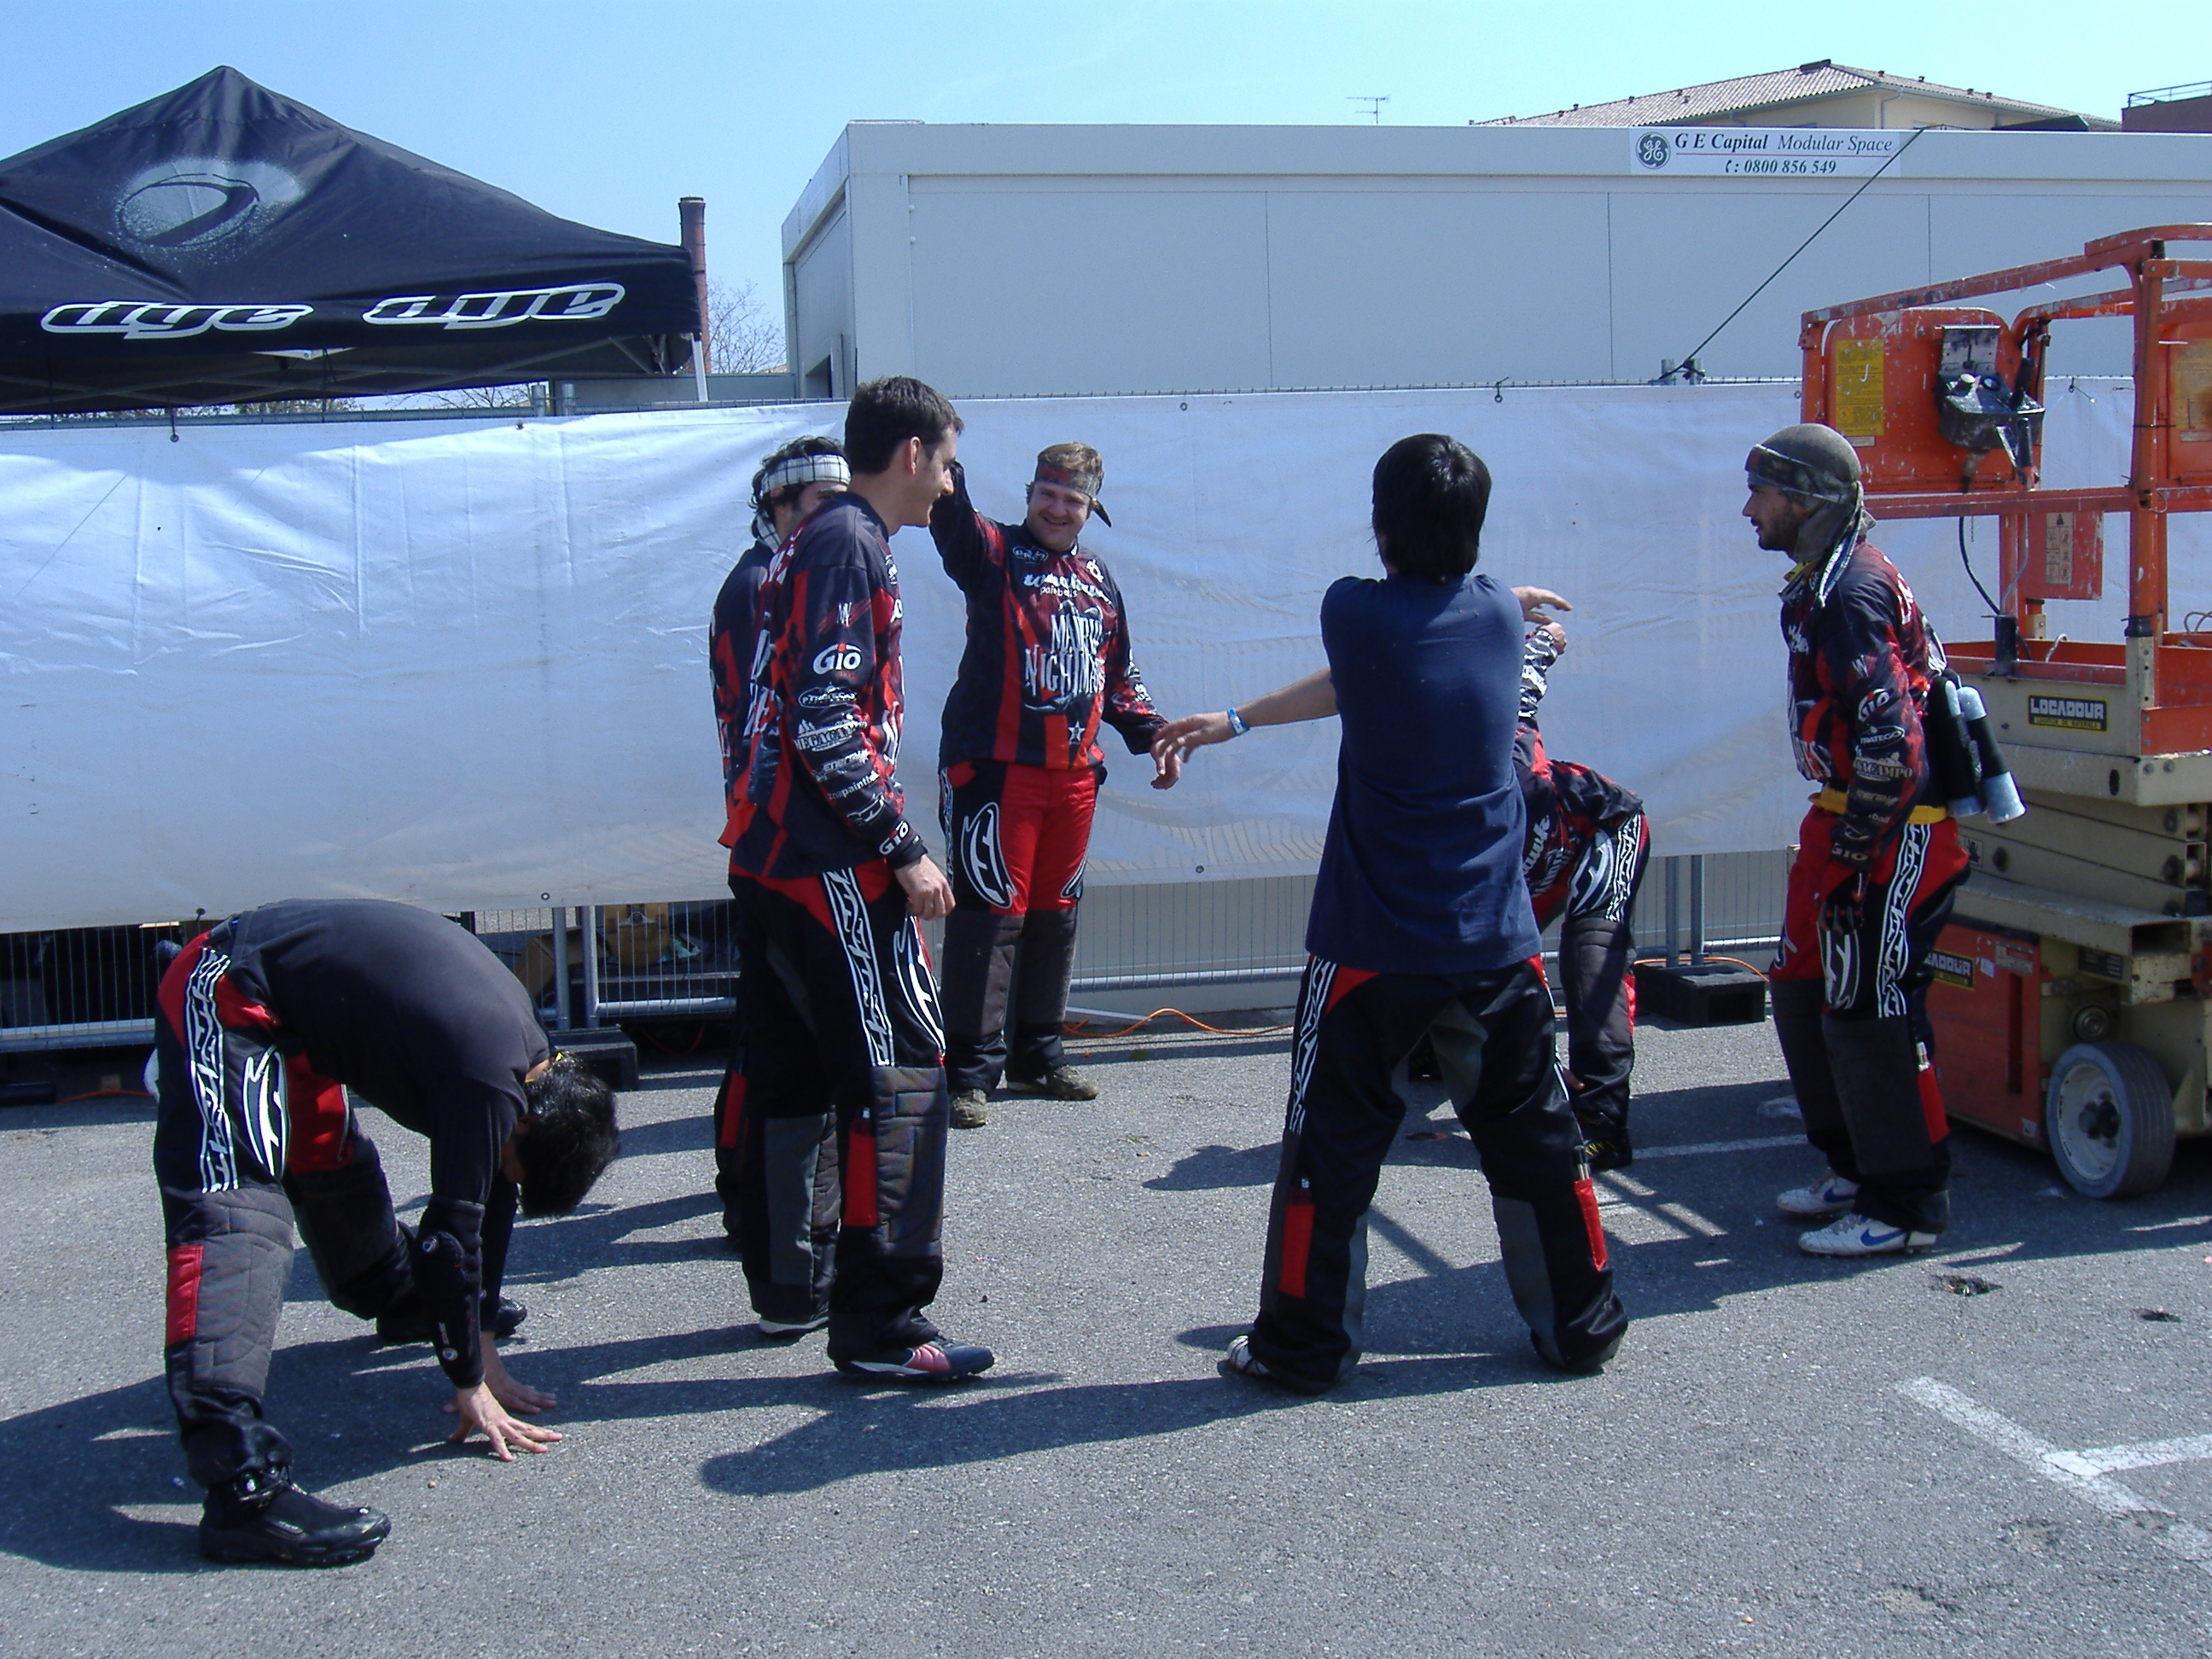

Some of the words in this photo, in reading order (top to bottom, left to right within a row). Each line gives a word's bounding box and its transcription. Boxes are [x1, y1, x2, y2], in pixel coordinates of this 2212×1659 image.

[1674, 132, 1689, 148] G
[1693, 132, 1708, 149] E
[1711, 133, 1768, 153] Capital
[1778, 134, 1844, 152] Modular
[1848, 135, 1893, 155] Space
[1744, 159, 1778, 173] 0800
[1782, 160, 1807, 173] 856
[1812, 160, 1837, 175] 549
[2030, 698, 2104, 719] LOCADOUR
[1925, 952, 1971, 977] ADOUR
